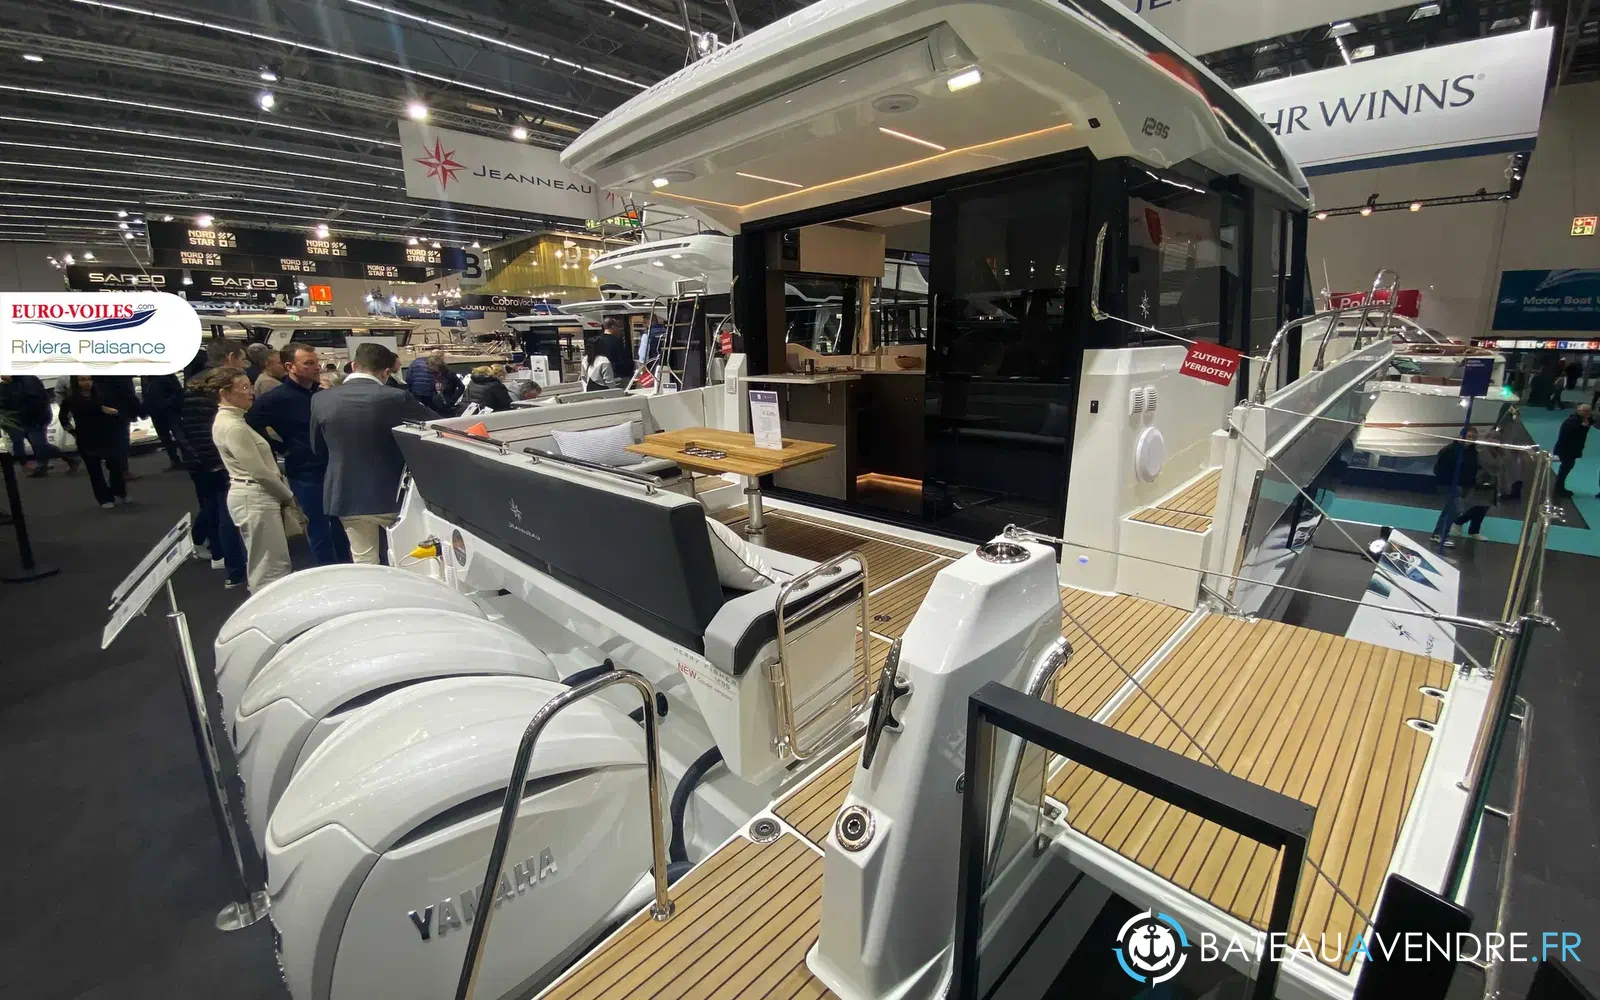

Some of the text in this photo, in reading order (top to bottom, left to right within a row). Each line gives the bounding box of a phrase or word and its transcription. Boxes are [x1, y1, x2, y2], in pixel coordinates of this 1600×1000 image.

[1319, 75, 1475, 127] WINNS
[1141, 115, 1171, 140] 1295
[473, 164, 592, 194] JEANNEAU
[188, 230, 216, 239] NORD
[189, 238, 215, 246] STAR
[306, 240, 330, 248] NORD
[180, 251, 204, 259] NORD
[307, 247, 329, 255] STAR
[406, 248, 426, 256] NORD
[181, 257, 203, 265] STAR
[280, 258, 301, 266] NORD
[406, 255, 426, 263] STAR
[367, 264, 385, 272] NORD
[88, 272, 166, 285] SARGO
[210, 276, 278, 288] SARGO
[320, 288, 326, 299] 1
[491, 296, 538, 307] CobraYach
[1192, 350, 1234, 367] ZUTRITT
[1184, 360, 1232, 380] VERBOTEN
[677, 662, 697, 680] NEW
